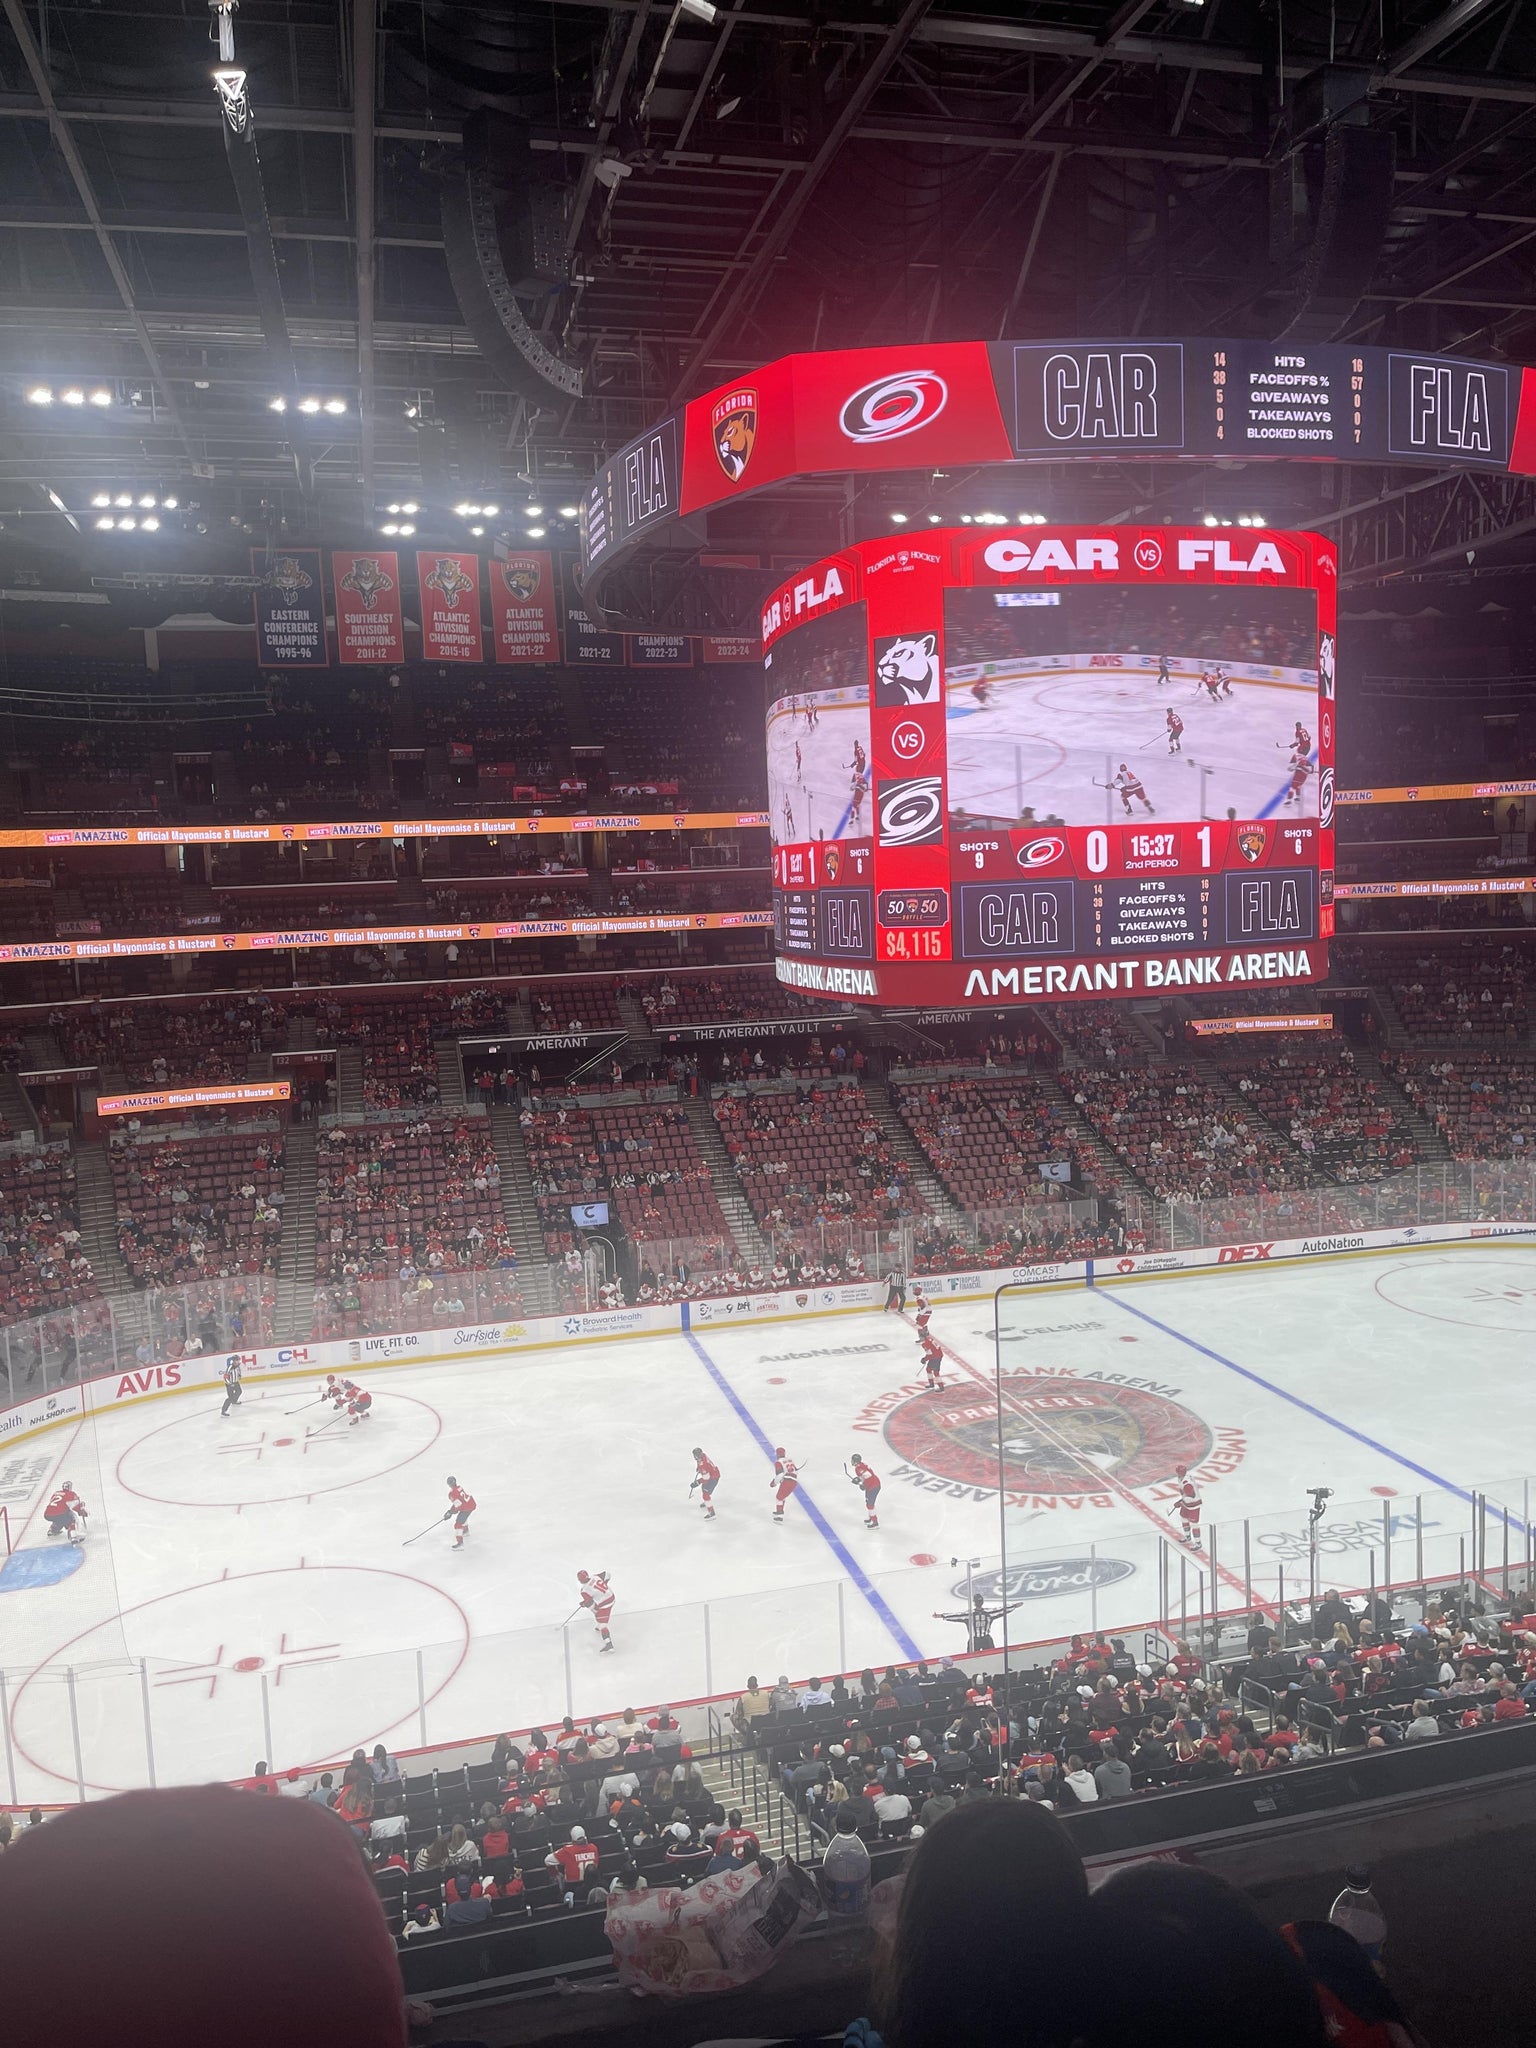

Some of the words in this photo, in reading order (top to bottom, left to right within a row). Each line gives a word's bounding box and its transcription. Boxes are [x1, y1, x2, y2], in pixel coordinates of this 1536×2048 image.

[1214, 352, 1226, 366] 14
[1275, 356, 1305, 368] HITS
[1250, 374, 1318, 386] FACEOFFS
[1320, 376, 1330, 387] %
[1352, 376, 1363, 390] 57
[1044, 354, 1157, 439] CAR
[1216, 389, 1223, 403] 5
[1251, 391, 1328, 405] GIVEAWAYS
[716, 395, 752, 421] FLORIDA
[1411, 365, 1491, 451] FLA
[1249, 409, 1331, 422] TAKEAWAYS
[1247, 428, 1297, 440] BLOCKED
[1298, 428, 1333, 440] SHOTS
[1354, 429, 1360, 443] 7
[626, 434, 667, 527] FLA
[984, 539, 1119, 572] CAR
[1178, 540, 1286, 574] FLA
[794, 568, 844, 615] FLA
[272, 610, 309, 620] EASTERN
[344, 614, 393, 624] SOUTHEAST
[433, 612, 470, 624] ATLANTIC
[506, 608, 544, 620] ATLANTIC
[264, 622, 318, 634] CONFERENCE
[351, 625, 388, 634] DIVISION
[434, 623, 469, 634] DIVISION
[508, 620, 544, 631] DIVISION
[266, 634, 318, 646] CHAMPIONS
[345, 636, 396, 646] CHAMPIONS
[428, 633, 476, 646] CHAMPIONS
[502, 632, 550, 644] CHAMPIONS
[638, 636, 684, 646] CHAMPIONS
[275, 648, 312, 658] 1995-96
[356, 648, 387, 658] 2011-12
[440, 646, 470, 657] 2015-16
[511, 645, 544, 656] 2021-22
[580, 647, 610, 658] 2021-22
[646, 648, 678, 658] 2022-23
[718, 646, 750, 656] 2023-24
[898, 734, 918, 748] VS
[332, 824, 382, 835] AMAZING
[394, 822, 424, 834] Official
[425, 821, 473, 834] Mayonnaise
[482, 821, 516, 832] Mustard
[595, 817, 640, 828] AMAZING
[74, 831, 128, 842] AMAZING
[138, 830, 170, 841] Official
[172, 829, 224, 842] Mayonnaise
[233, 828, 270, 839] Mustard
[1284, 829, 1312, 838] SHOTS
[850, 848, 870, 858] SHOTS
[960, 842, 999, 852] SHOTS
[1086, 830, 1108, 873] 0
[1131, 834, 1175, 857] 15:37
[1197, 826, 1210, 868] 1
[1295, 838, 1302, 854] 6
[808, 846, 816, 884] 1
[857, 858, 862, 874] 6
[975, 852, 984, 869] 9
[1126, 860, 1144, 870] 2nd
[1144, 859, 1178, 868] PERIOD
[1140, 882, 1166, 890] HITS
[1352, 884, 1398, 894] AMAZING
[1402, 884, 1430, 894] Official
[1432, 883, 1478, 894] Mayonnaise
[1490, 881, 1525, 890] Mustard
[887, 900, 905, 914] 50
[921, 900, 938, 914] 50
[1119, 894, 1176, 906] FACEOFFS
[1242, 880, 1300, 932] FLA
[979, 892, 1058, 946] CAR
[1120, 907, 1186, 918] GIVEAWAYS
[520, 922, 567, 933] AMAZING
[572, 921, 600, 932] Official
[602, 920, 648, 932] Mayonnaise
[658, 918, 690, 928] Mustard
[828, 900, 862, 948] FLA
[1118, 920, 1188, 932] TAKEAWAYS
[278, 932, 329, 944] AMAZING
[334, 931, 364, 943] Official
[367, 928, 417, 943] Mayonnaise
[427, 926, 462, 938] Mustard
[1110, 934, 1160, 945] BLOCKED
[1160, 932, 1194, 942] SHOTS
[12, 944, 71, 958] AMAZING
[76, 941, 110, 955] Official
[112, 940, 166, 954] Mayonnaise
[178, 938, 216, 950] Mustard
[886, 931, 941, 960] $4,115
[797, 963, 824, 990] BANK
[826, 966, 877, 996] ARENA
[964, 961, 1140, 998] AMERANT
[1144, 956, 1222, 987] BANK
[1227, 950, 1312, 981] ARENA
[917, 1012, 972, 1024] AMERANT
[1203, 1022, 1232, 1030] AMAZING
[1295, 1018, 1318, 1026] Mustard
[694, 1030, 714, 1040] THE
[718, 1025, 776, 1039] AMERANT
[779, 1022, 820, 1035] VAULT
[526, 1037, 588, 1051] AMERANT
[122, 1096, 164, 1107] AMAZING
[169, 1094, 194, 1104] Official
[196, 1092, 236, 1104] Mayonnaise
[244, 1088, 274, 1098] Mustard
[1302, 1236, 1364, 1252] AutoNation
[1218, 1244, 1276, 1263] DEX
[1013, 1266, 1060, 1278] COMCAST
[582, 1316, 616, 1326] Broward
[617, 1312, 642, 1322] Health
[1023, 1321, 1104, 1335] CELSIUS
[366, 1339, 387, 1350] LIVE.
[389, 1338, 404, 1348] FIT.
[406, 1336, 420, 1346] GO.
[454, 1328, 500, 1344] Surfside
[759, 1343, 890, 1364] AutoNation
[116, 1364, 182, 1398] AVIS
[989, 1366, 1080, 1378] BANK
[1083, 1370, 1184, 1398] ARENA
[886, 1462, 999, 1502] ARENA
[1002, 1493, 1116, 1510] BANK
[1257, 1520, 1382, 1547] OMEGA
[1272, 1532, 1389, 1561] SPORT
[993, 1566, 1101, 1596] Ford
